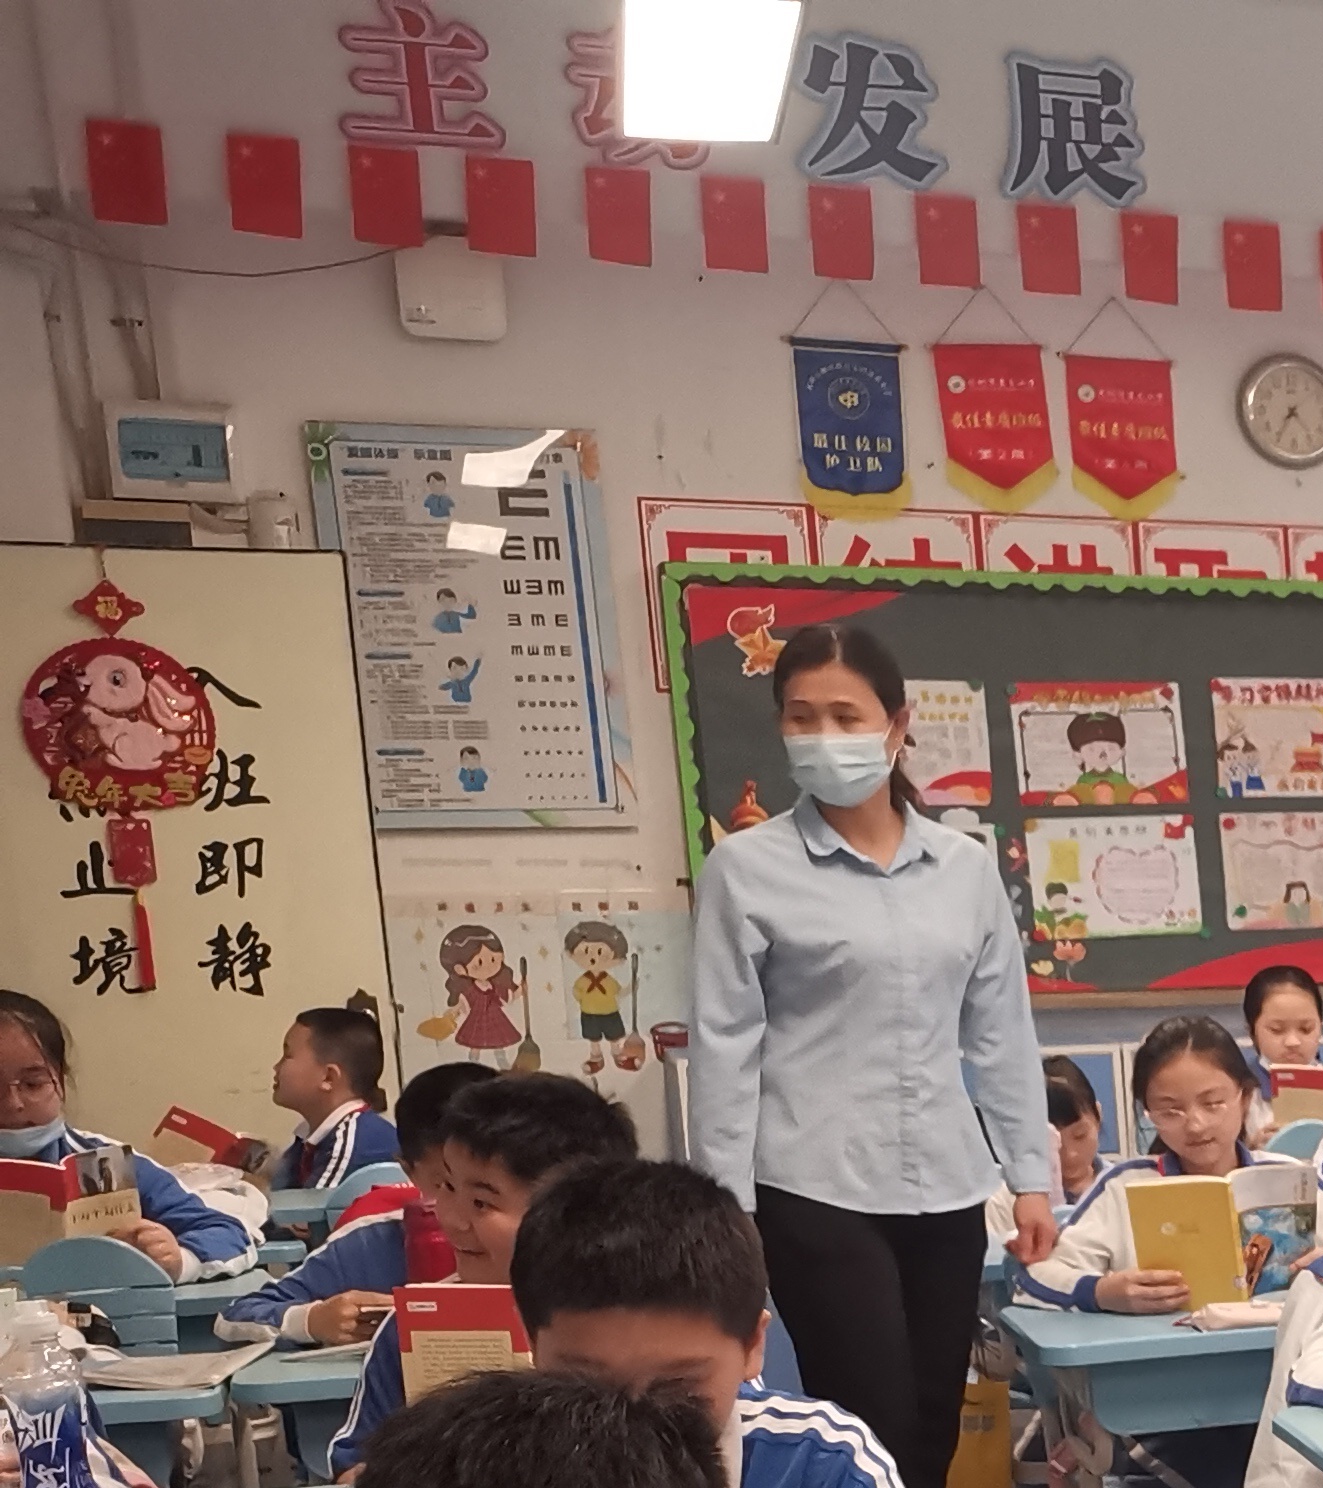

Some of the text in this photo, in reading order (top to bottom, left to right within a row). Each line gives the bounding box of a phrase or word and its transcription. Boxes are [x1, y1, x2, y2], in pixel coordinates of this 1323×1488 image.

[339, 0, 1140, 206] 主发展
[58, 767, 197, 807] 兔年大吉
